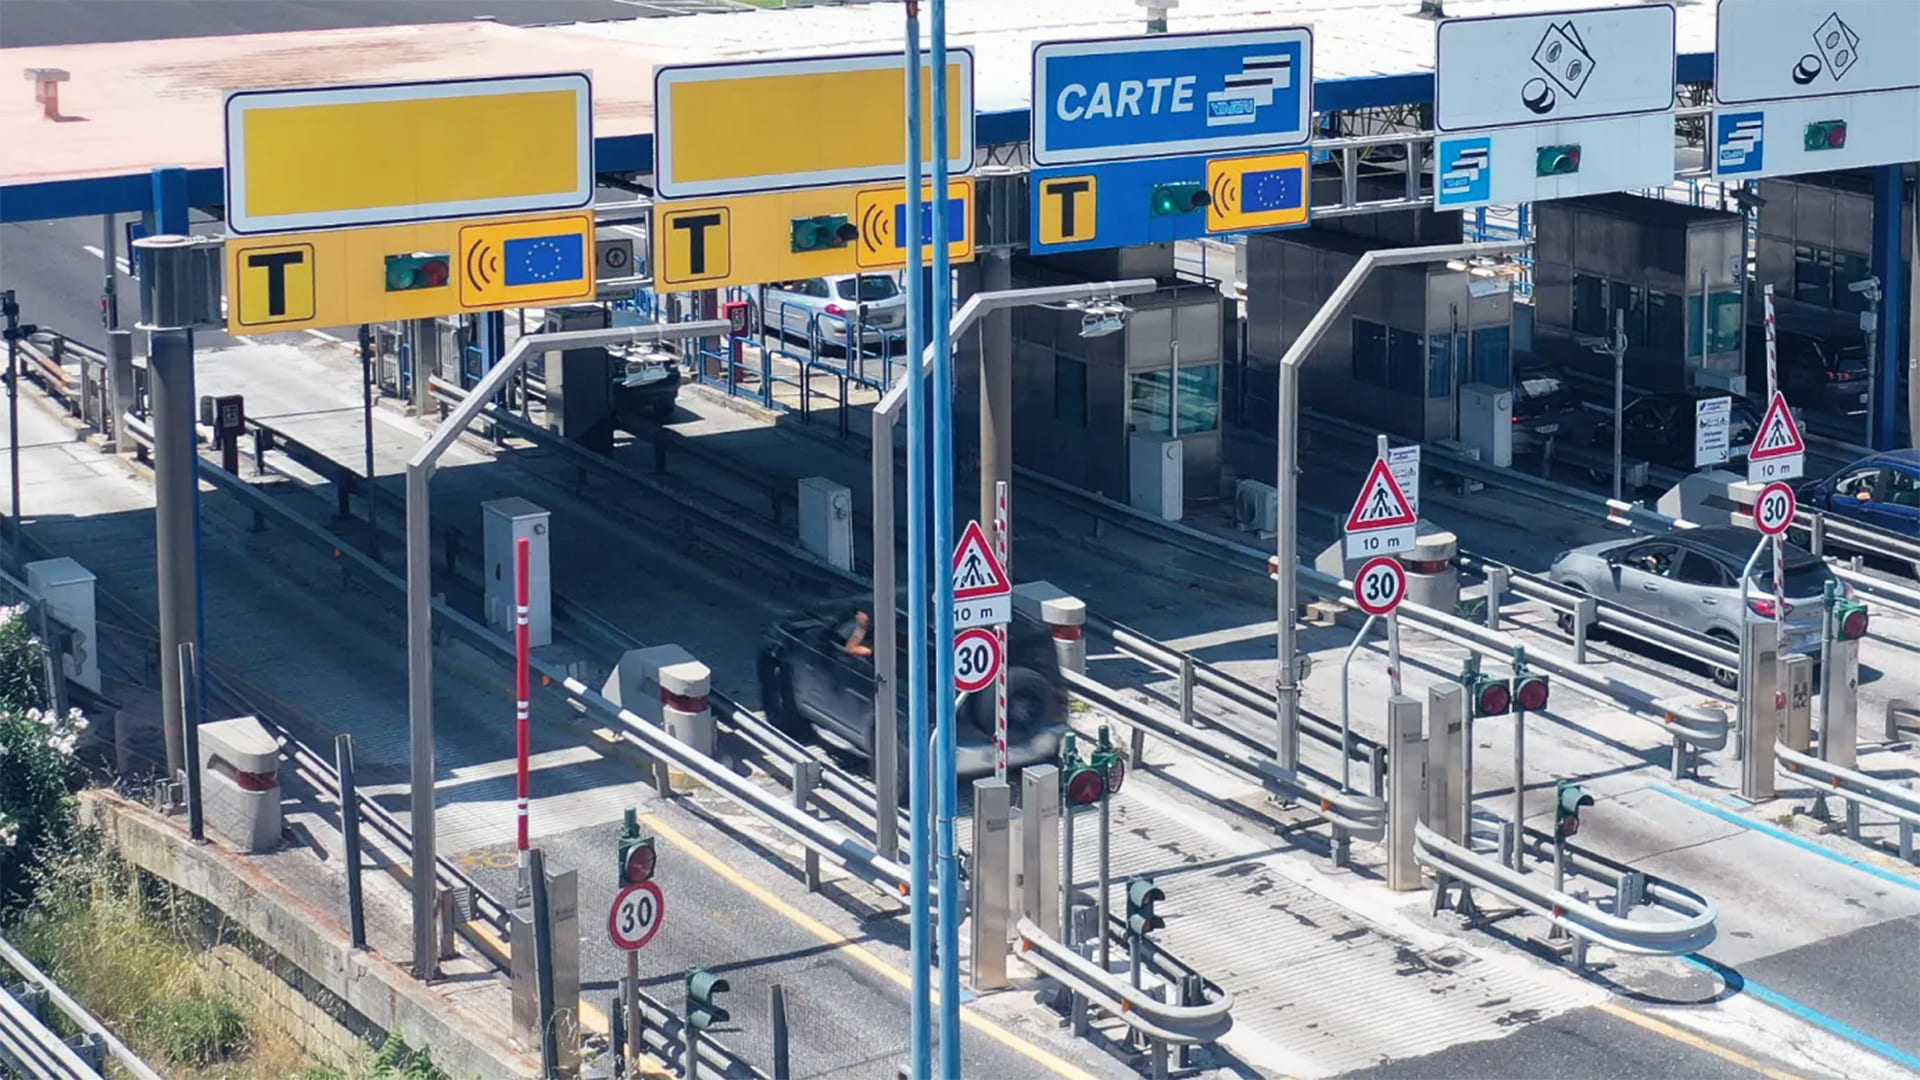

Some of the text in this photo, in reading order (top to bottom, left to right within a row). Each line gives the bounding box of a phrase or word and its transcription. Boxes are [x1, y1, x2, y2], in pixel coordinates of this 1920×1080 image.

[1055, 74, 1197, 121] CARTE
[1046, 180, 1090, 238] T
[673, 213, 721, 275] T
[248, 250, 304, 316] T
[1761, 464, 1790, 477] 10 m
[1764, 496, 1786, 522] 30
[1363, 537, 1400, 551] 10 m
[1366, 572, 1395, 600] 30
[953, 607, 993, 622] 10 m
[958, 644, 989, 676] 30
[622, 896, 653, 934] 30
